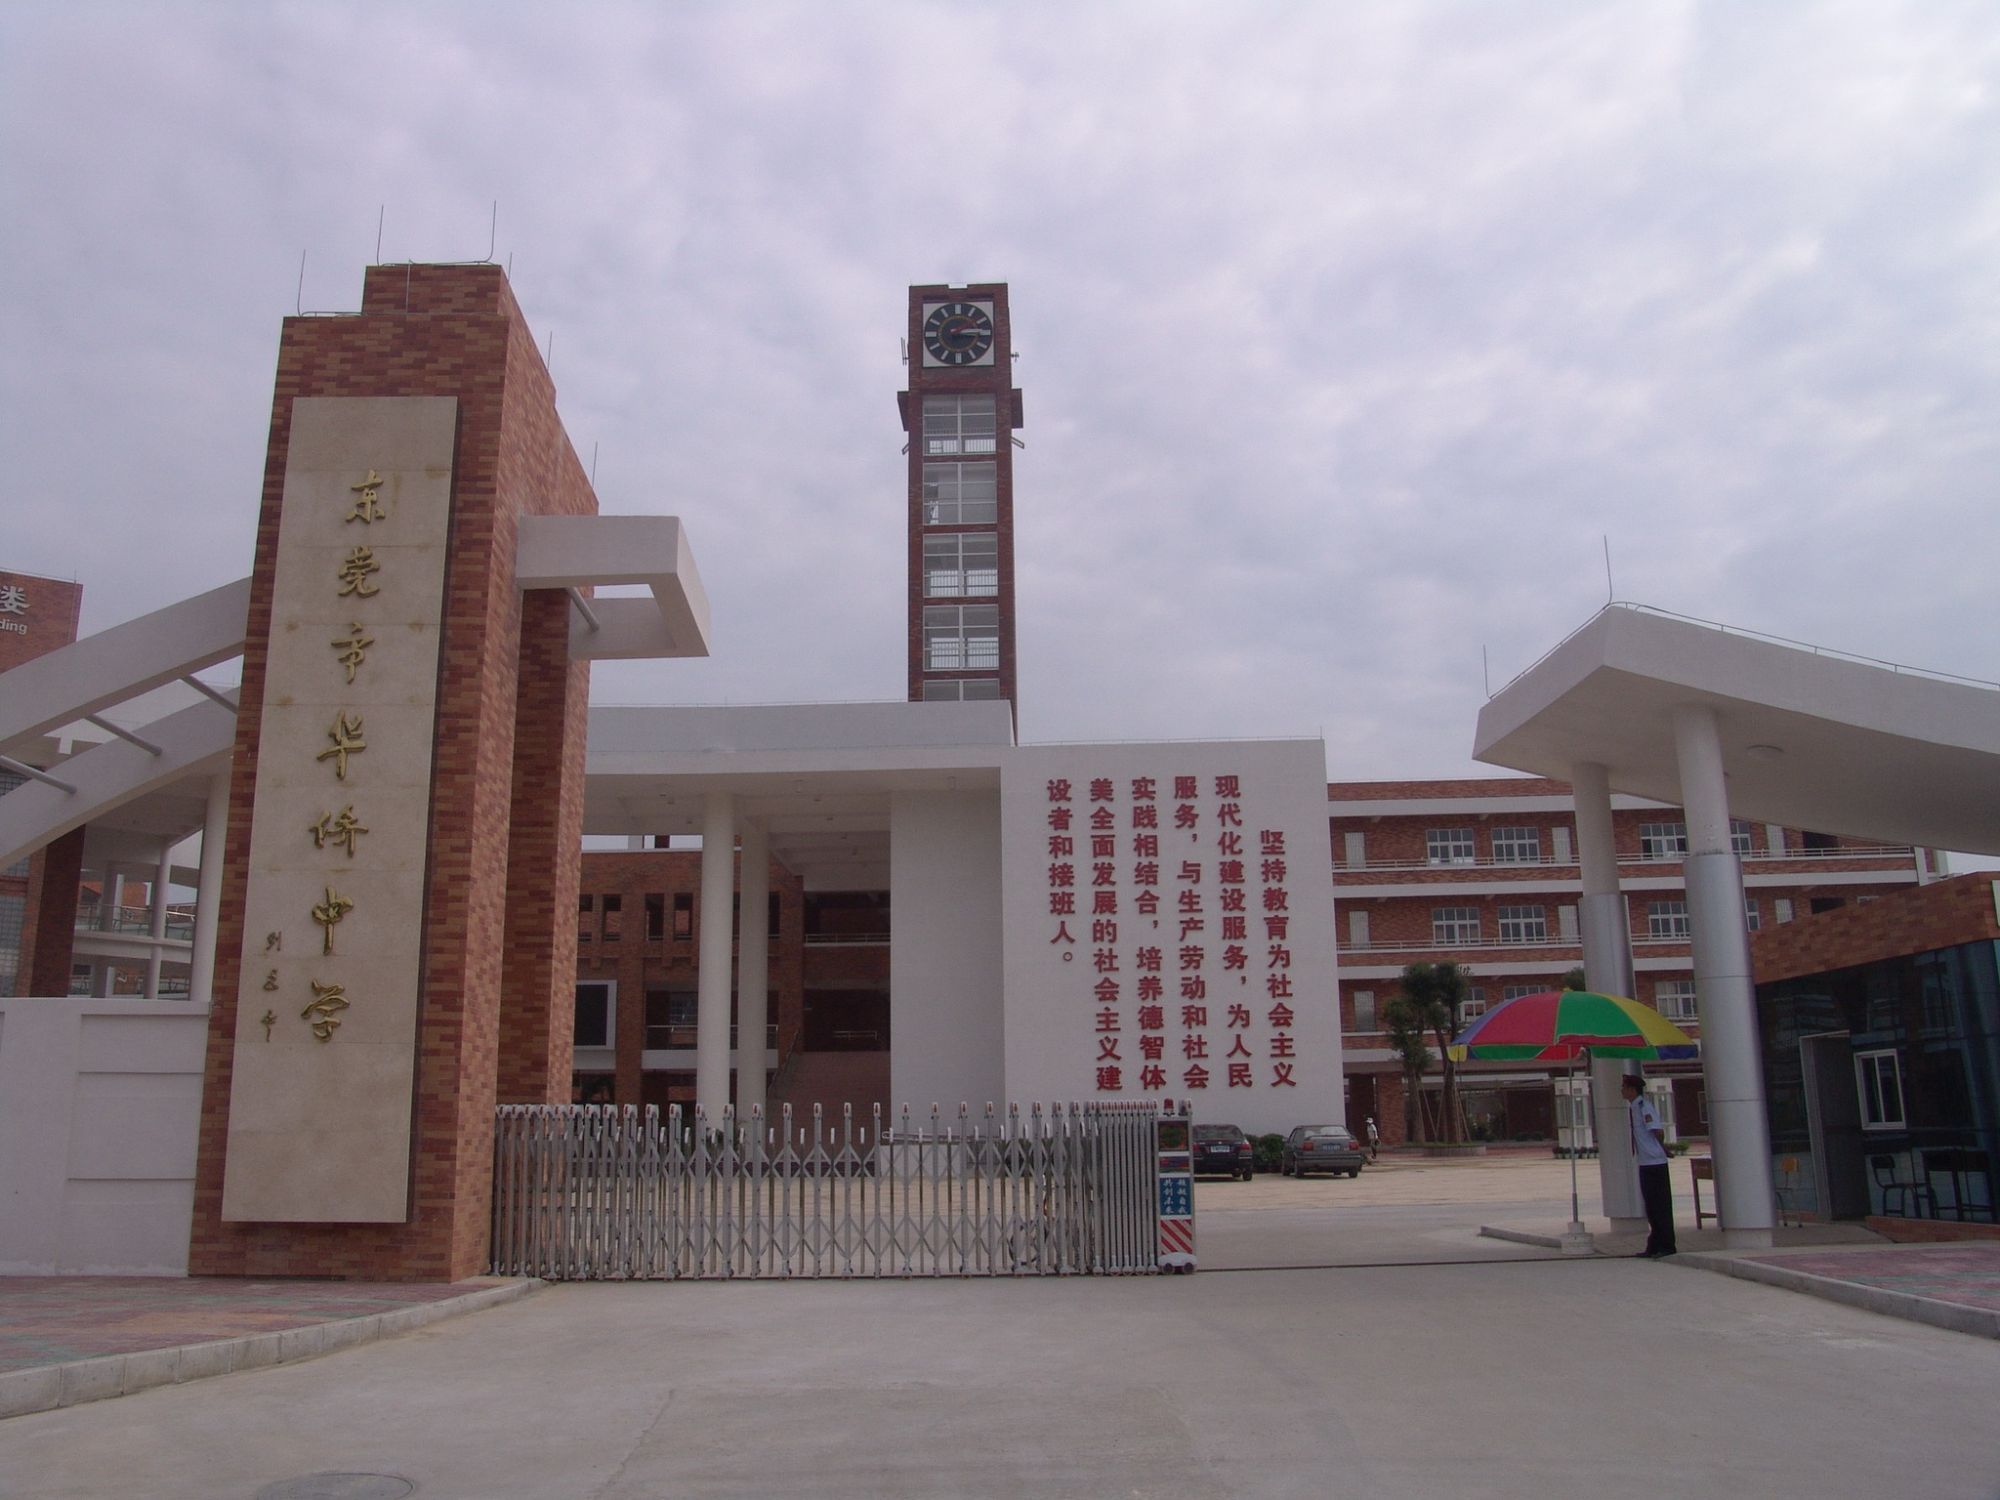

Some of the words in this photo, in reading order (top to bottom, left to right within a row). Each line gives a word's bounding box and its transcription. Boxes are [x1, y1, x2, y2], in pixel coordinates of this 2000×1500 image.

[301, 470, 386, 1043] 东莞市华侨中学
[1047, 779, 1076, 962] 设者和接班人。
[1090, 778, 1123, 1092] 美全面发展的社会主义建
[1131, 777, 1167, 1090] 实践相结合，培养德智体
[1174, 776, 1210, 1089] 服务，与生产劳动和社会
[1215, 775, 1253, 1088] 现代化建设服务，为人民
[1260, 830, 1297, 1088] 坚持教育为社会主义
